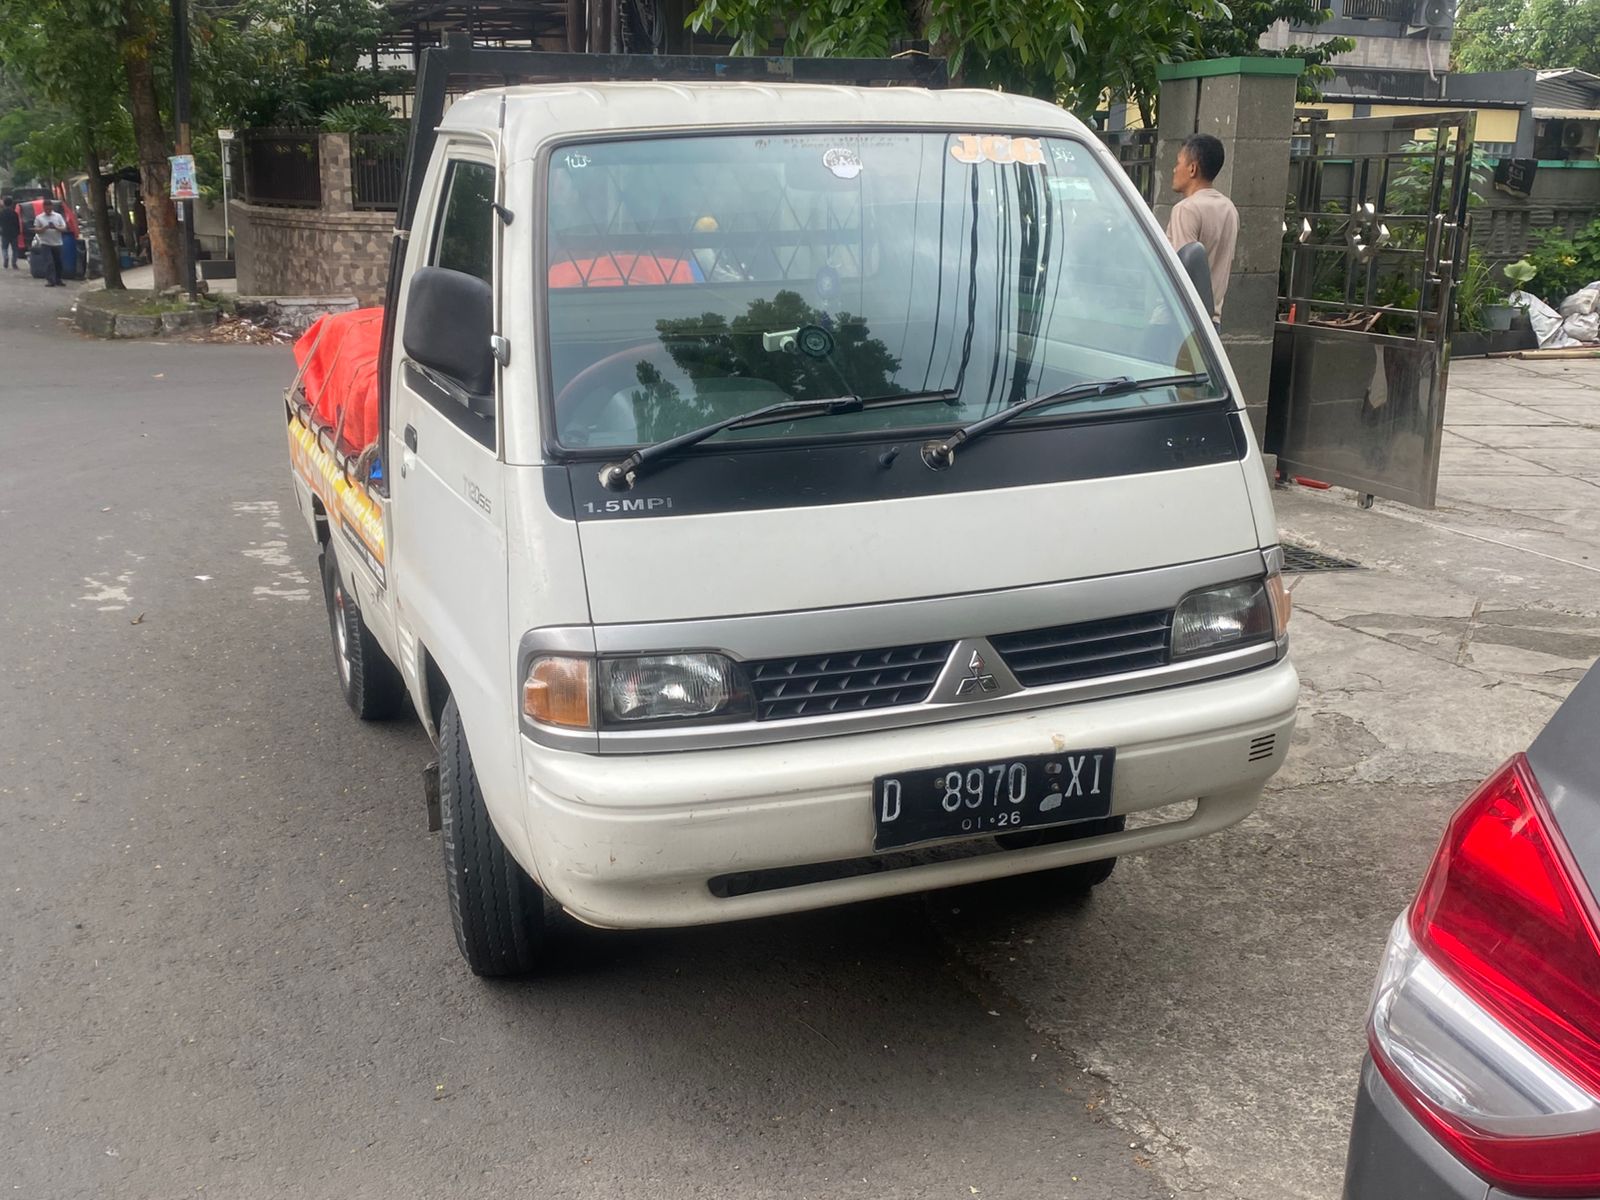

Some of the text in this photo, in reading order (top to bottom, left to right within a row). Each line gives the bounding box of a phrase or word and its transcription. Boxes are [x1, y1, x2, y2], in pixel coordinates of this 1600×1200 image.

[881, 754, 1104, 823] D 8970 XI
